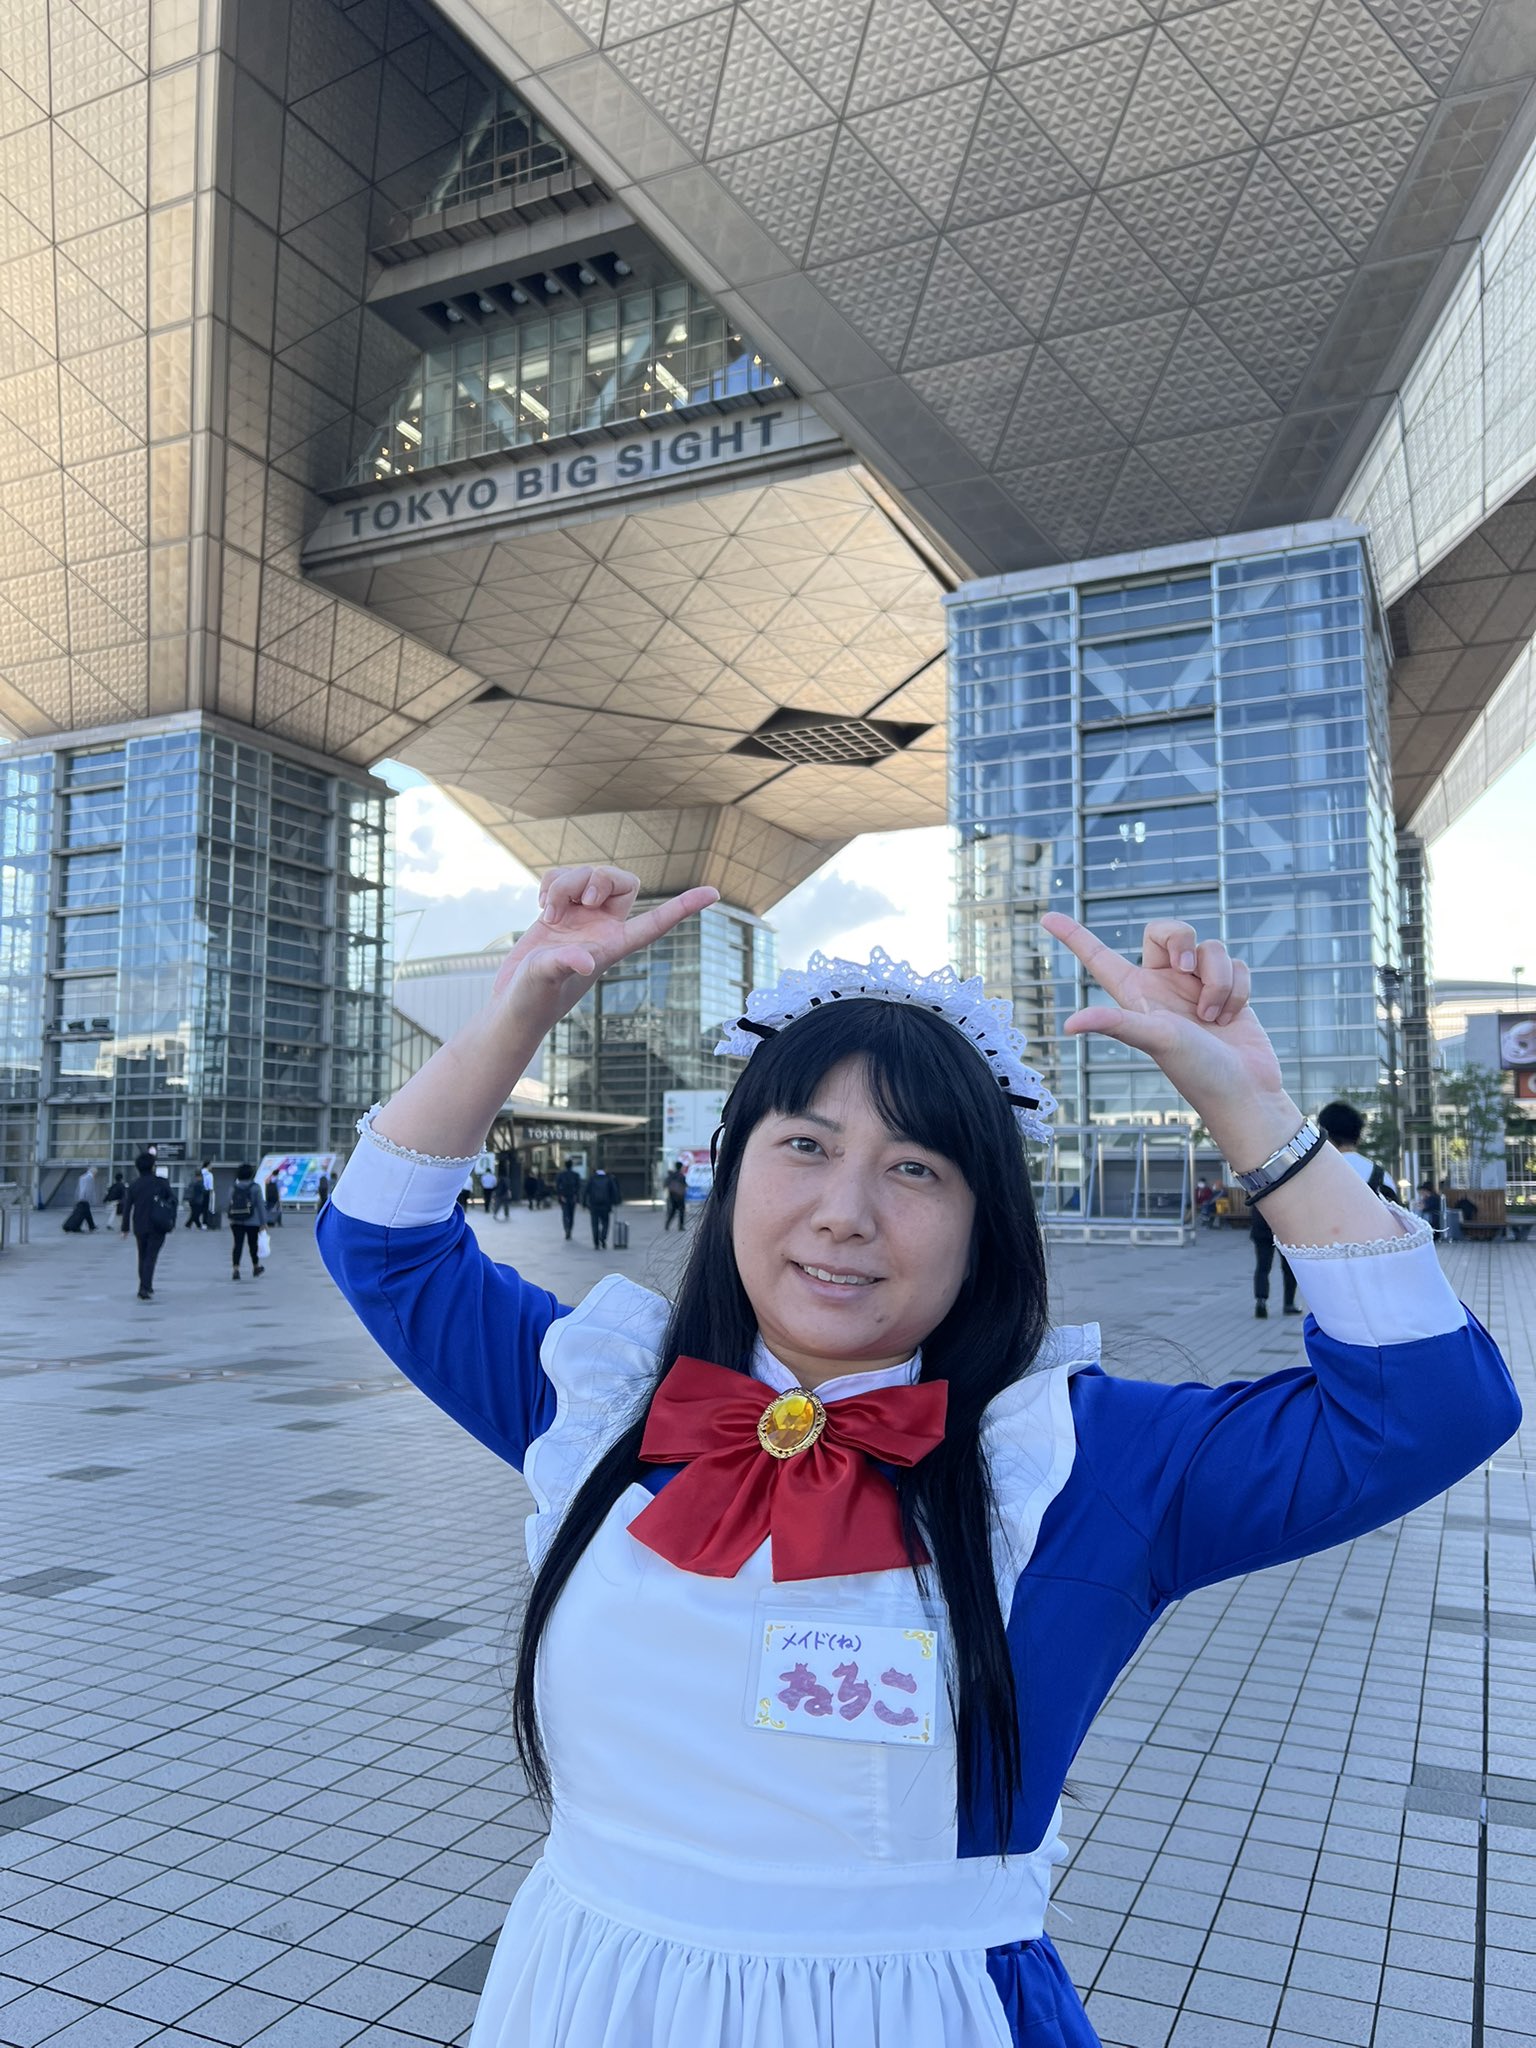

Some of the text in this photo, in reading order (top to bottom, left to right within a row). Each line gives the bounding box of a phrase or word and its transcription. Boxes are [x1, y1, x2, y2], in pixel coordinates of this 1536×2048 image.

[345, 411, 783, 536] TOKYO BIG SIGHT
[528, 1127, 563, 1140] TOKYO
